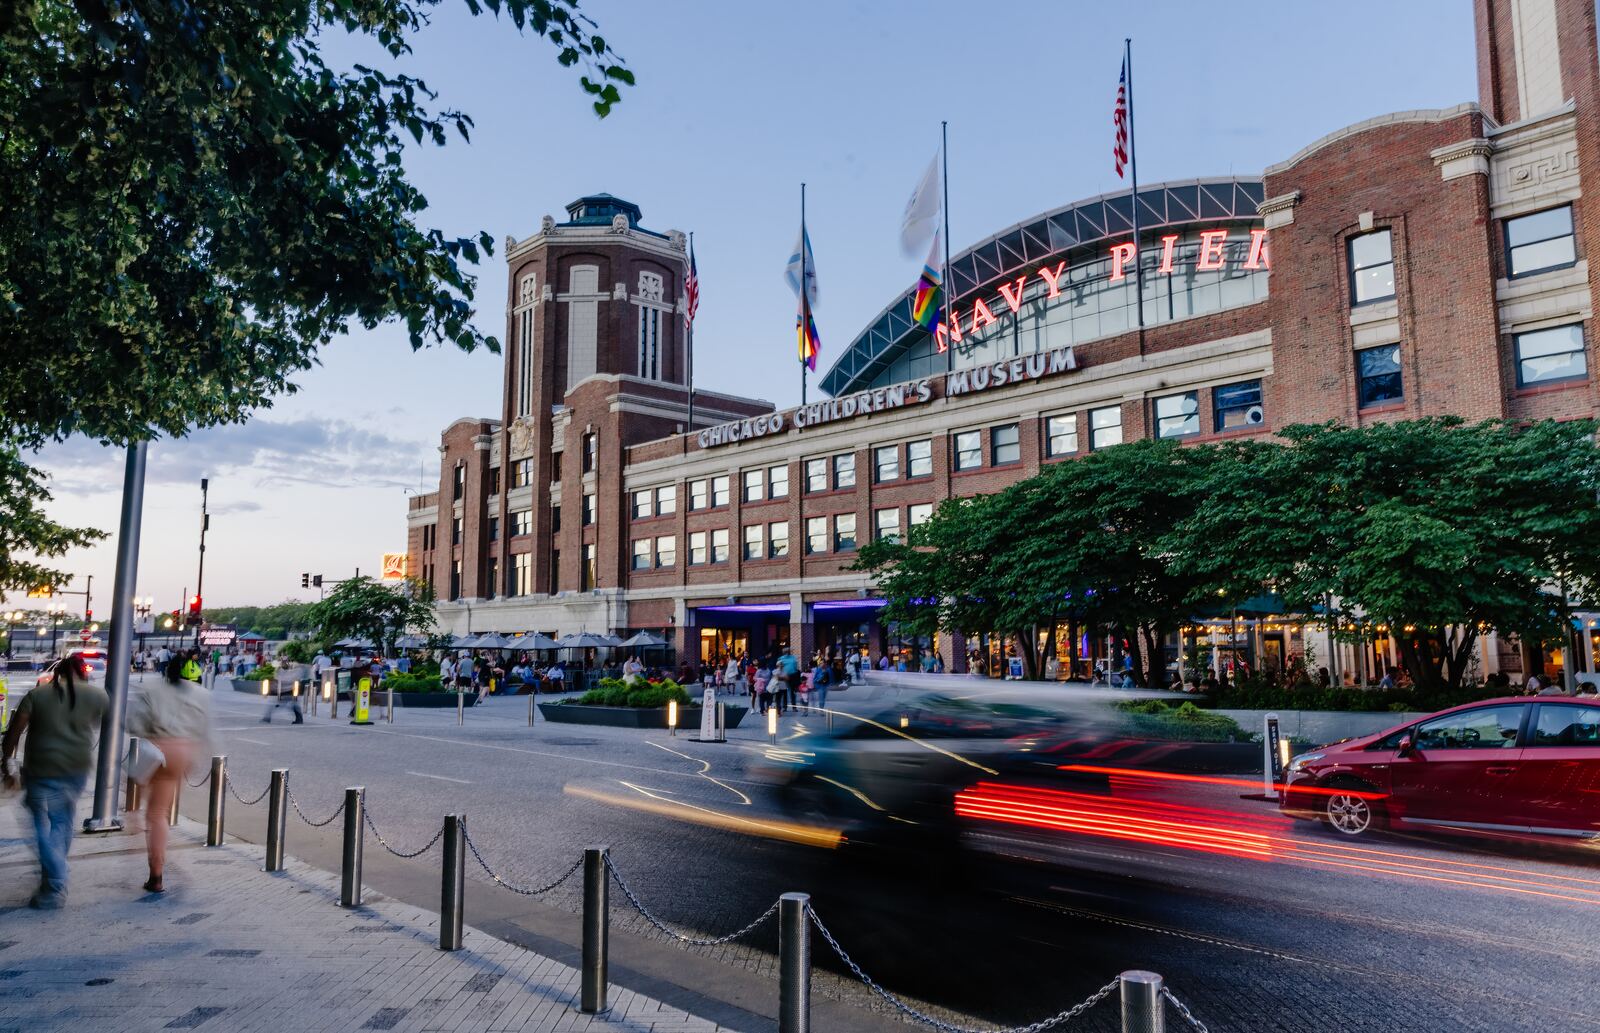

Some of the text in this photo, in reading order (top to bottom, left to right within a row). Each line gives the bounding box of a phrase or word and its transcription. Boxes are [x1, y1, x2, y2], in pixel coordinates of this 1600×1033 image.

[935, 261, 1066, 353] NAVY
[698, 346, 1077, 449] CHICAGO CHILDREN'S MUSEUM
